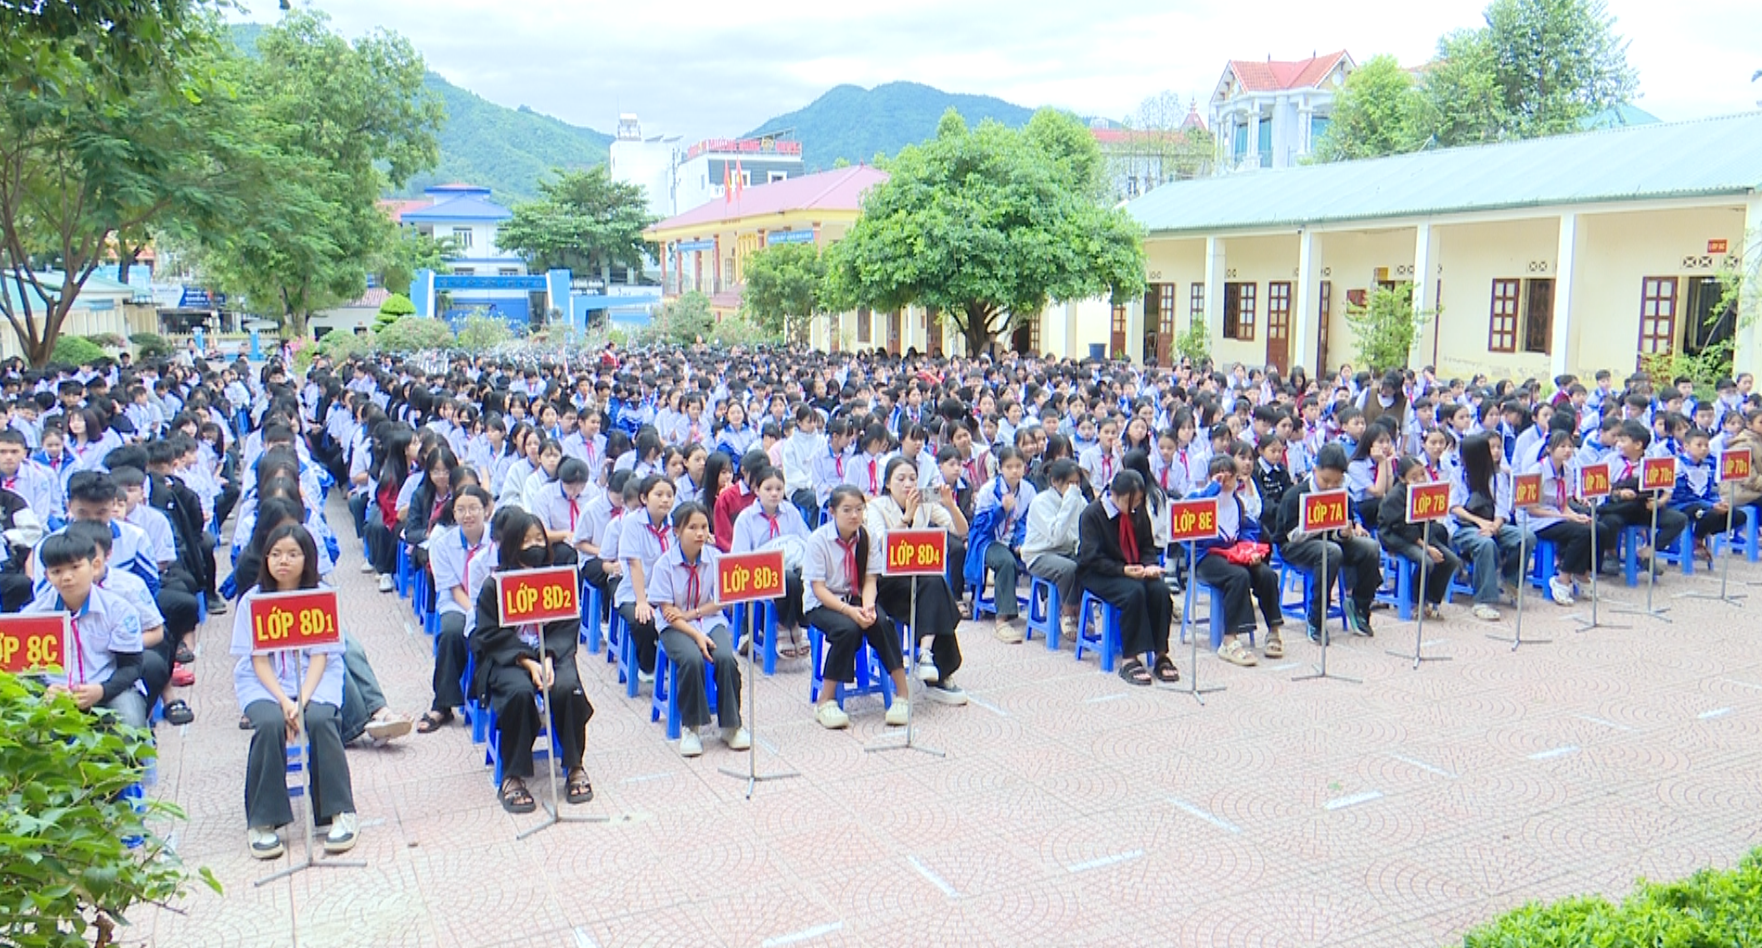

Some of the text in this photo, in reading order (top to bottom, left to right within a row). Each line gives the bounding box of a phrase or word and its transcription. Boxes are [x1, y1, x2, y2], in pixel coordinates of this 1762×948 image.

[1646, 464, 1659, 484] LỚP
[1723, 456, 1734, 475] LỚP
[1527, 483, 1537, 500] 7C
[1583, 471, 1595, 491] LỚP
[1308, 501, 1342, 524] LỚP 7A
[1413, 492, 1446, 515] LỚP 7B
[1174, 509, 1212, 533] LỚP 8E
[890, 540, 940, 567] LỚP 8D4
[723, 564, 779, 593] LỚP 8D3
[506, 582, 571, 614] LỚP 8D2
[256, 605, 334, 641] LỚP 8D1
[26, 634, 58, 663] 8C
